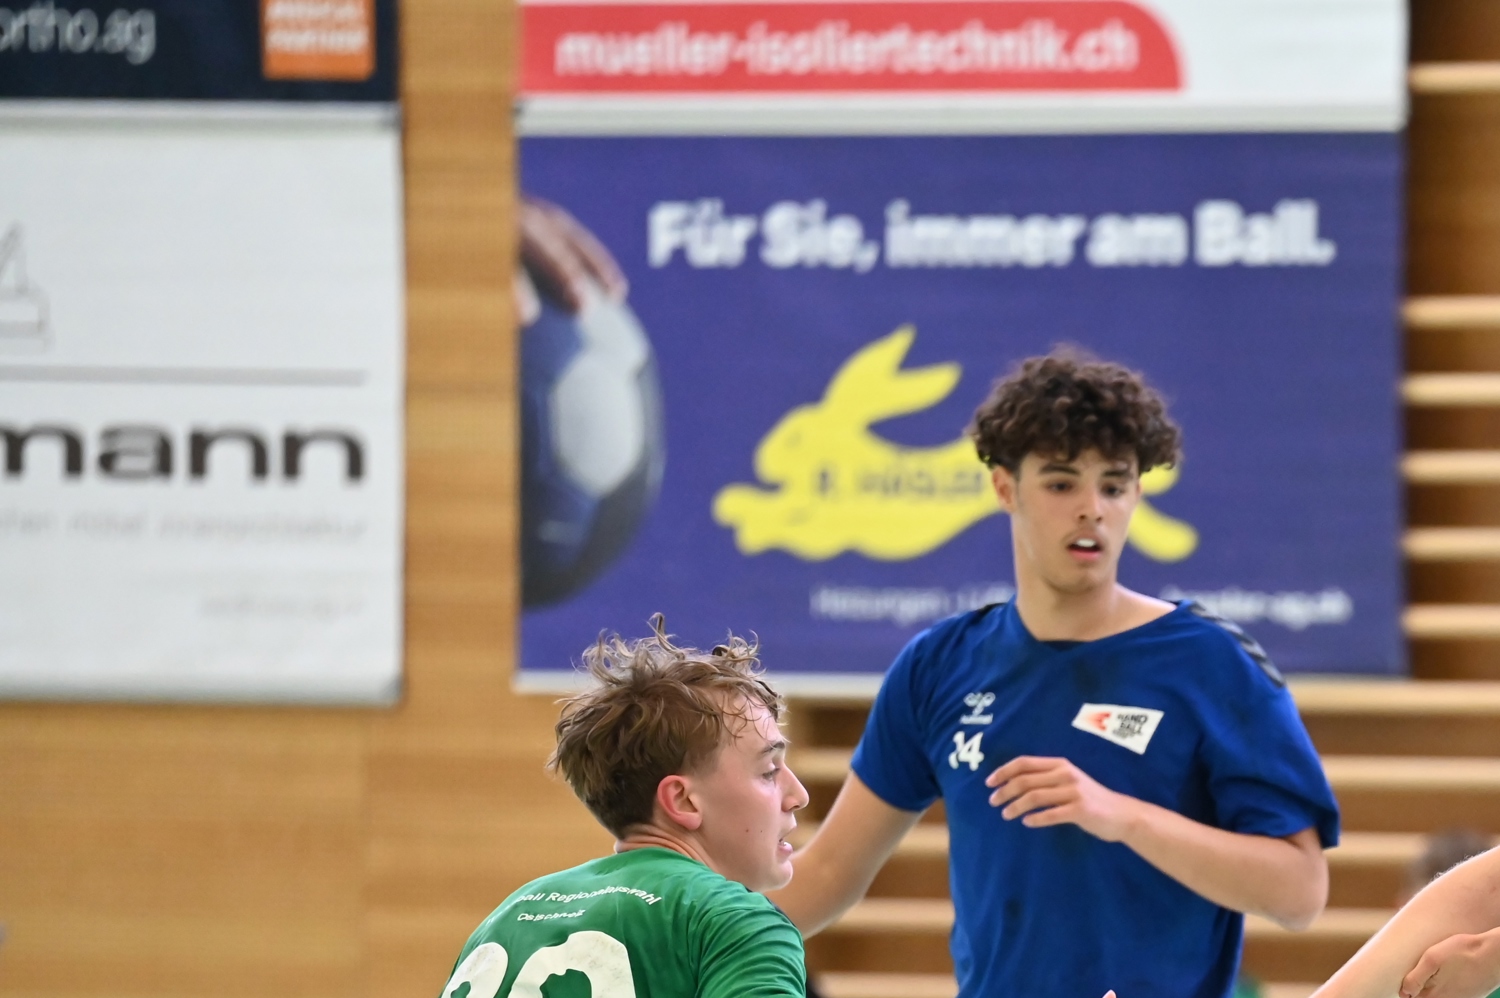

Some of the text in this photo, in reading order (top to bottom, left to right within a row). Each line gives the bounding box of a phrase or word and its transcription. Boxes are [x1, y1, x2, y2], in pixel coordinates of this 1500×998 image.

[556, 19, 1137, 76] mueller-isoliertechnik.ch
[647, 198, 1335, 274] Für Sie, immer am Ball.
[949, 730, 985, 771] 14
